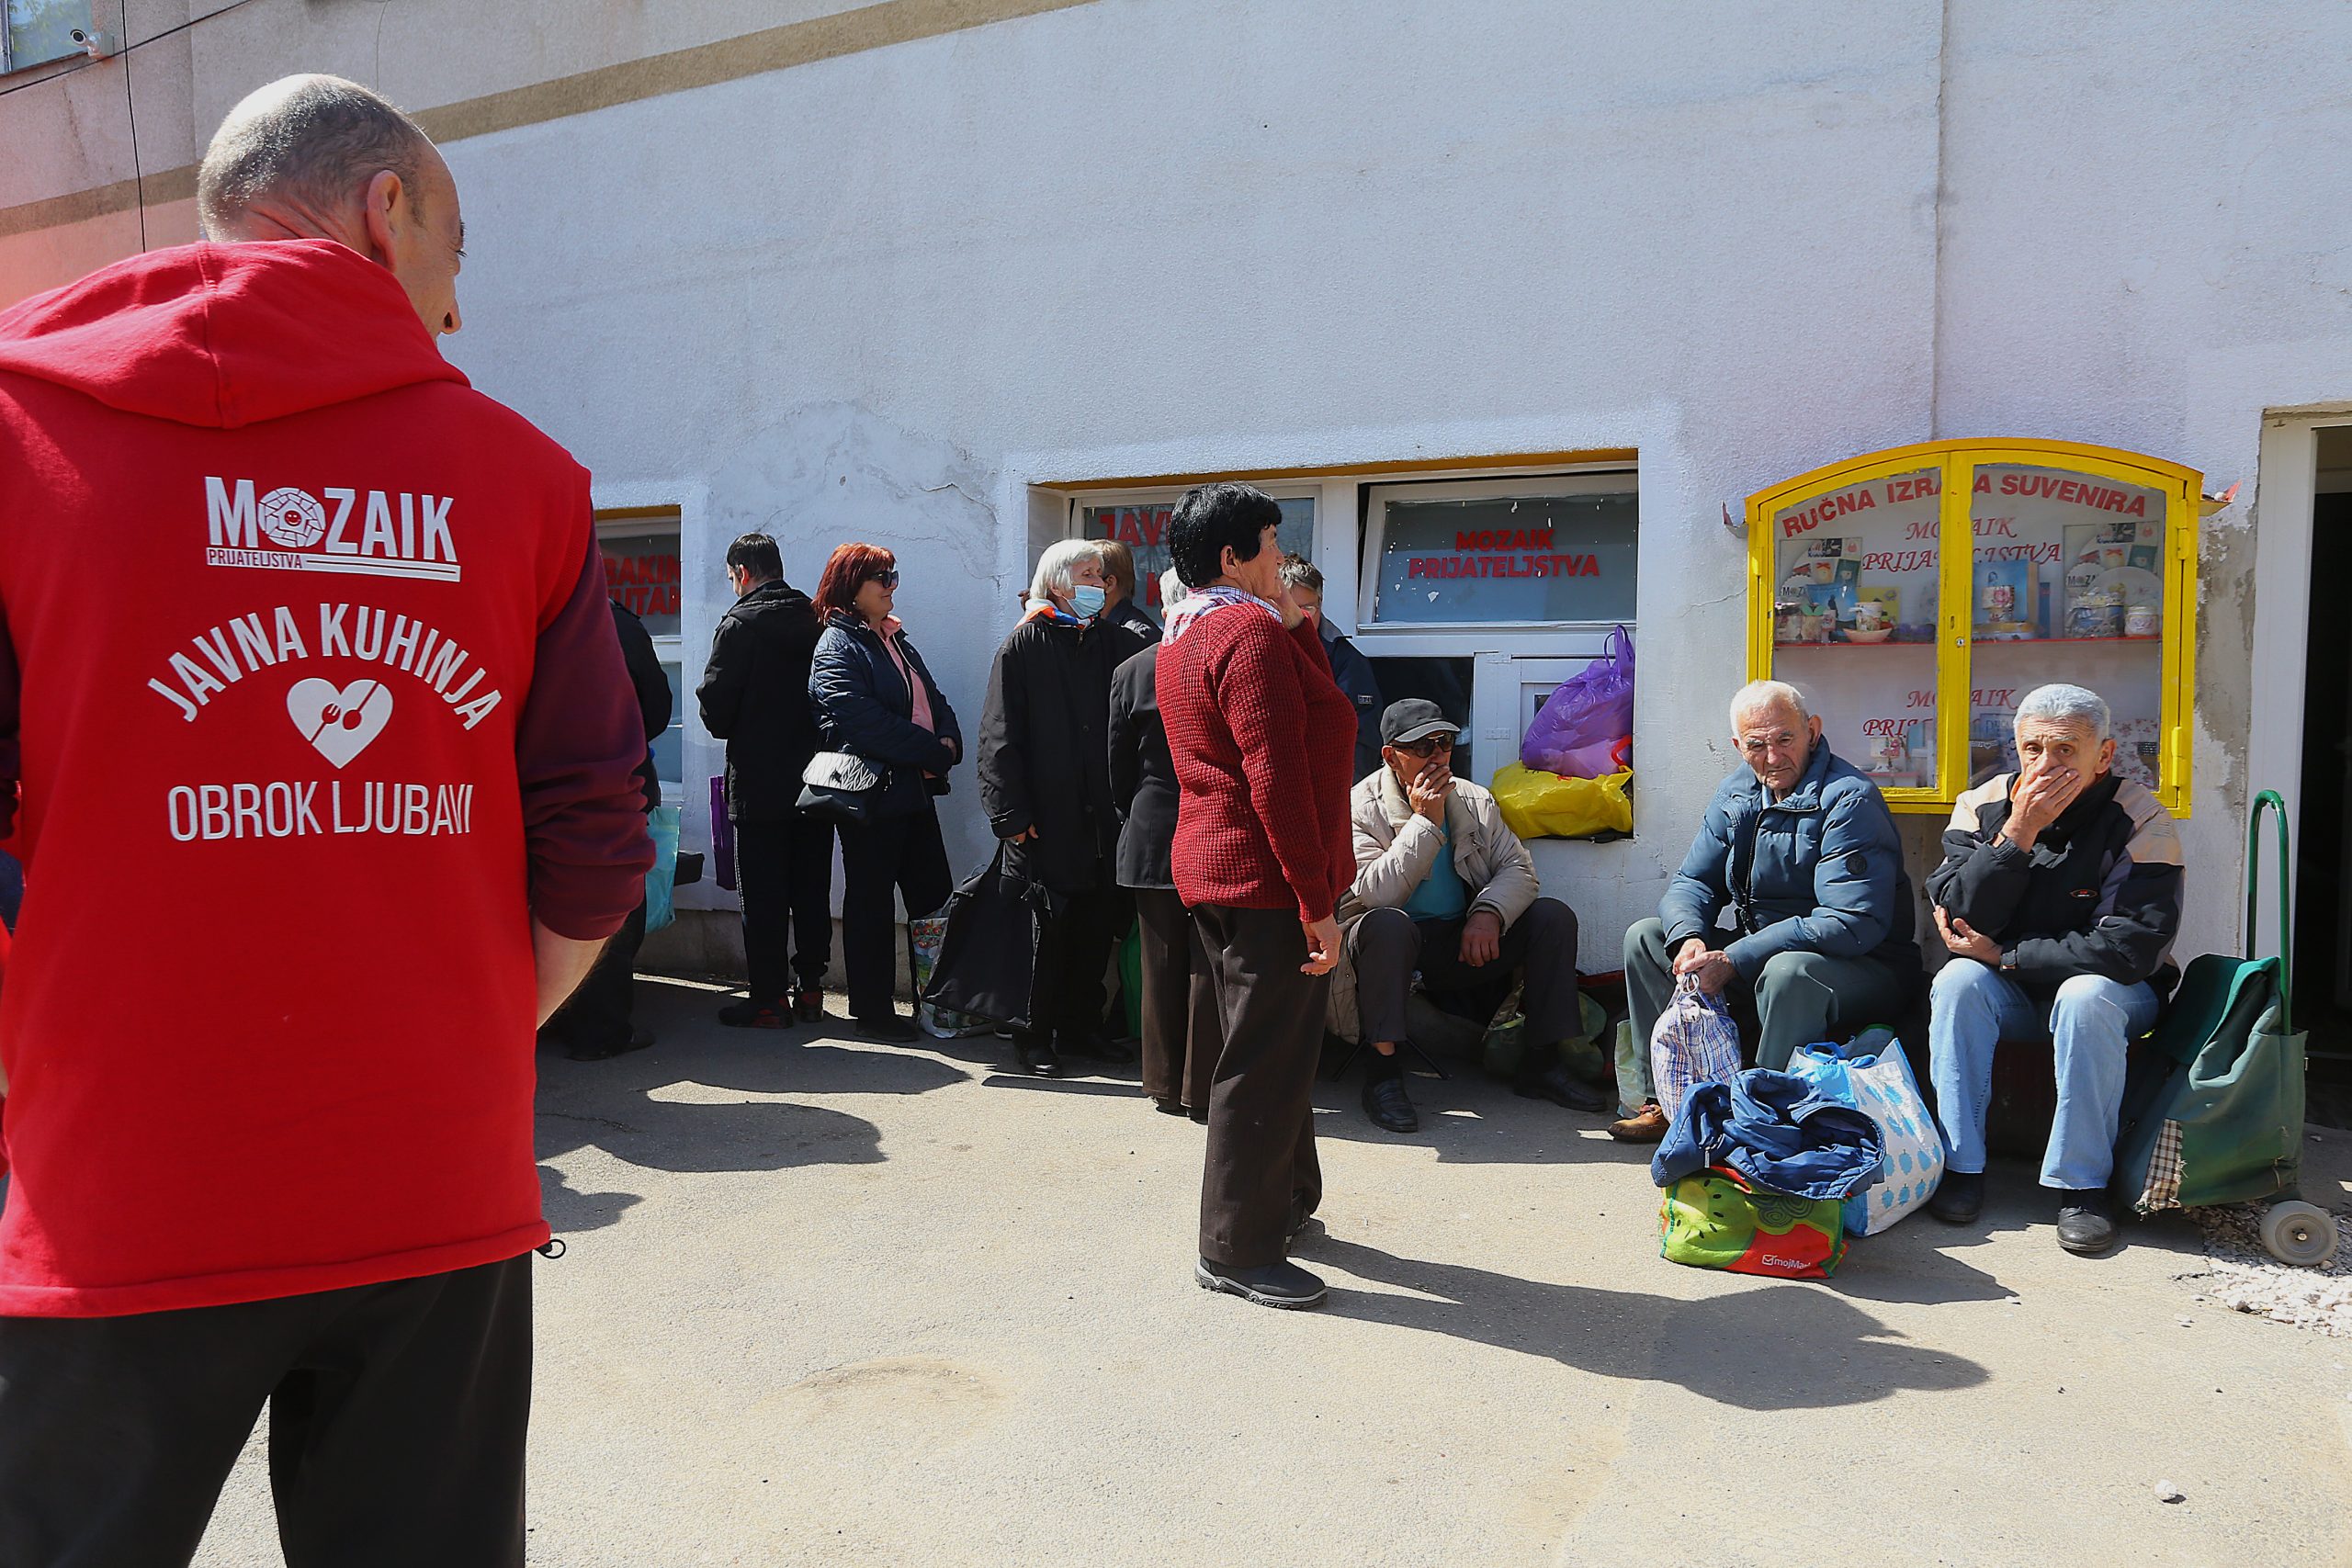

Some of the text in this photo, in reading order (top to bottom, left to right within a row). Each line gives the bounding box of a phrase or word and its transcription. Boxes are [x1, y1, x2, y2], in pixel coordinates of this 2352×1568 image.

[1782, 489, 1876, 538] RUČNA
[2000, 474, 2146, 517] SUVENIRA
[1100, 510, 1173, 547] JAV
[1455, 529, 1555, 551] MOZAIK
[209, 549, 303, 569] PRIJATELJSTVA
[1408, 555, 1600, 579] PRIJATELJSTVA
[147, 603, 503, 731] JAVNA KUHINJA
[168, 781, 474, 840] OBROK LJUBAVI
